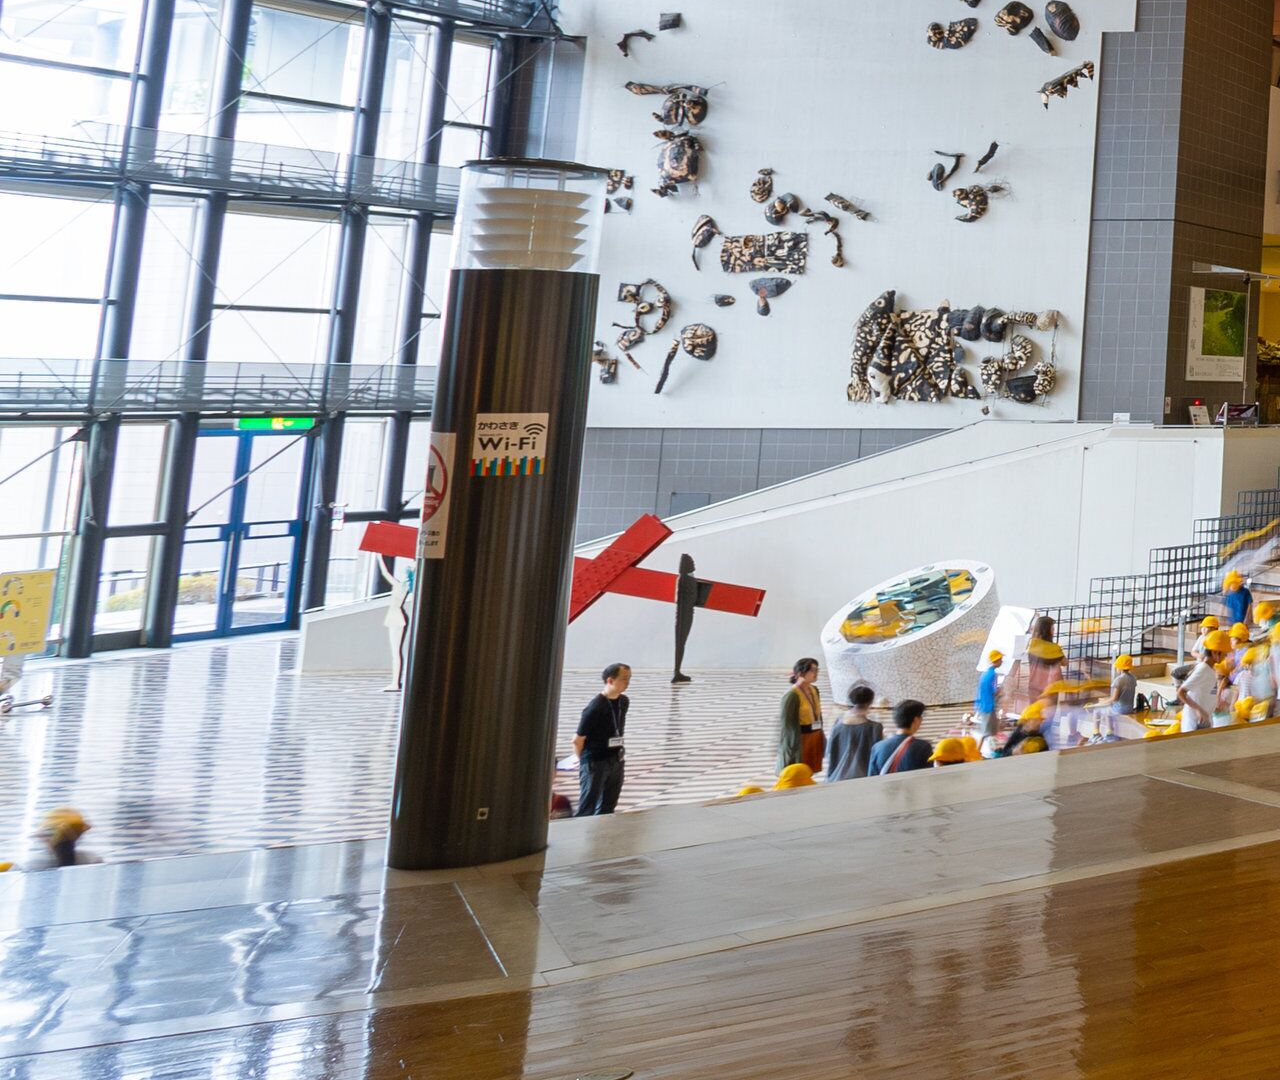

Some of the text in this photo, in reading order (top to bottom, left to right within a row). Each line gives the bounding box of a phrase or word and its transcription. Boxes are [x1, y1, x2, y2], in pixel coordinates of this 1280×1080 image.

[477, 422, 520, 430] かわさき
[478, 436, 537, 451] Wi-Fi
